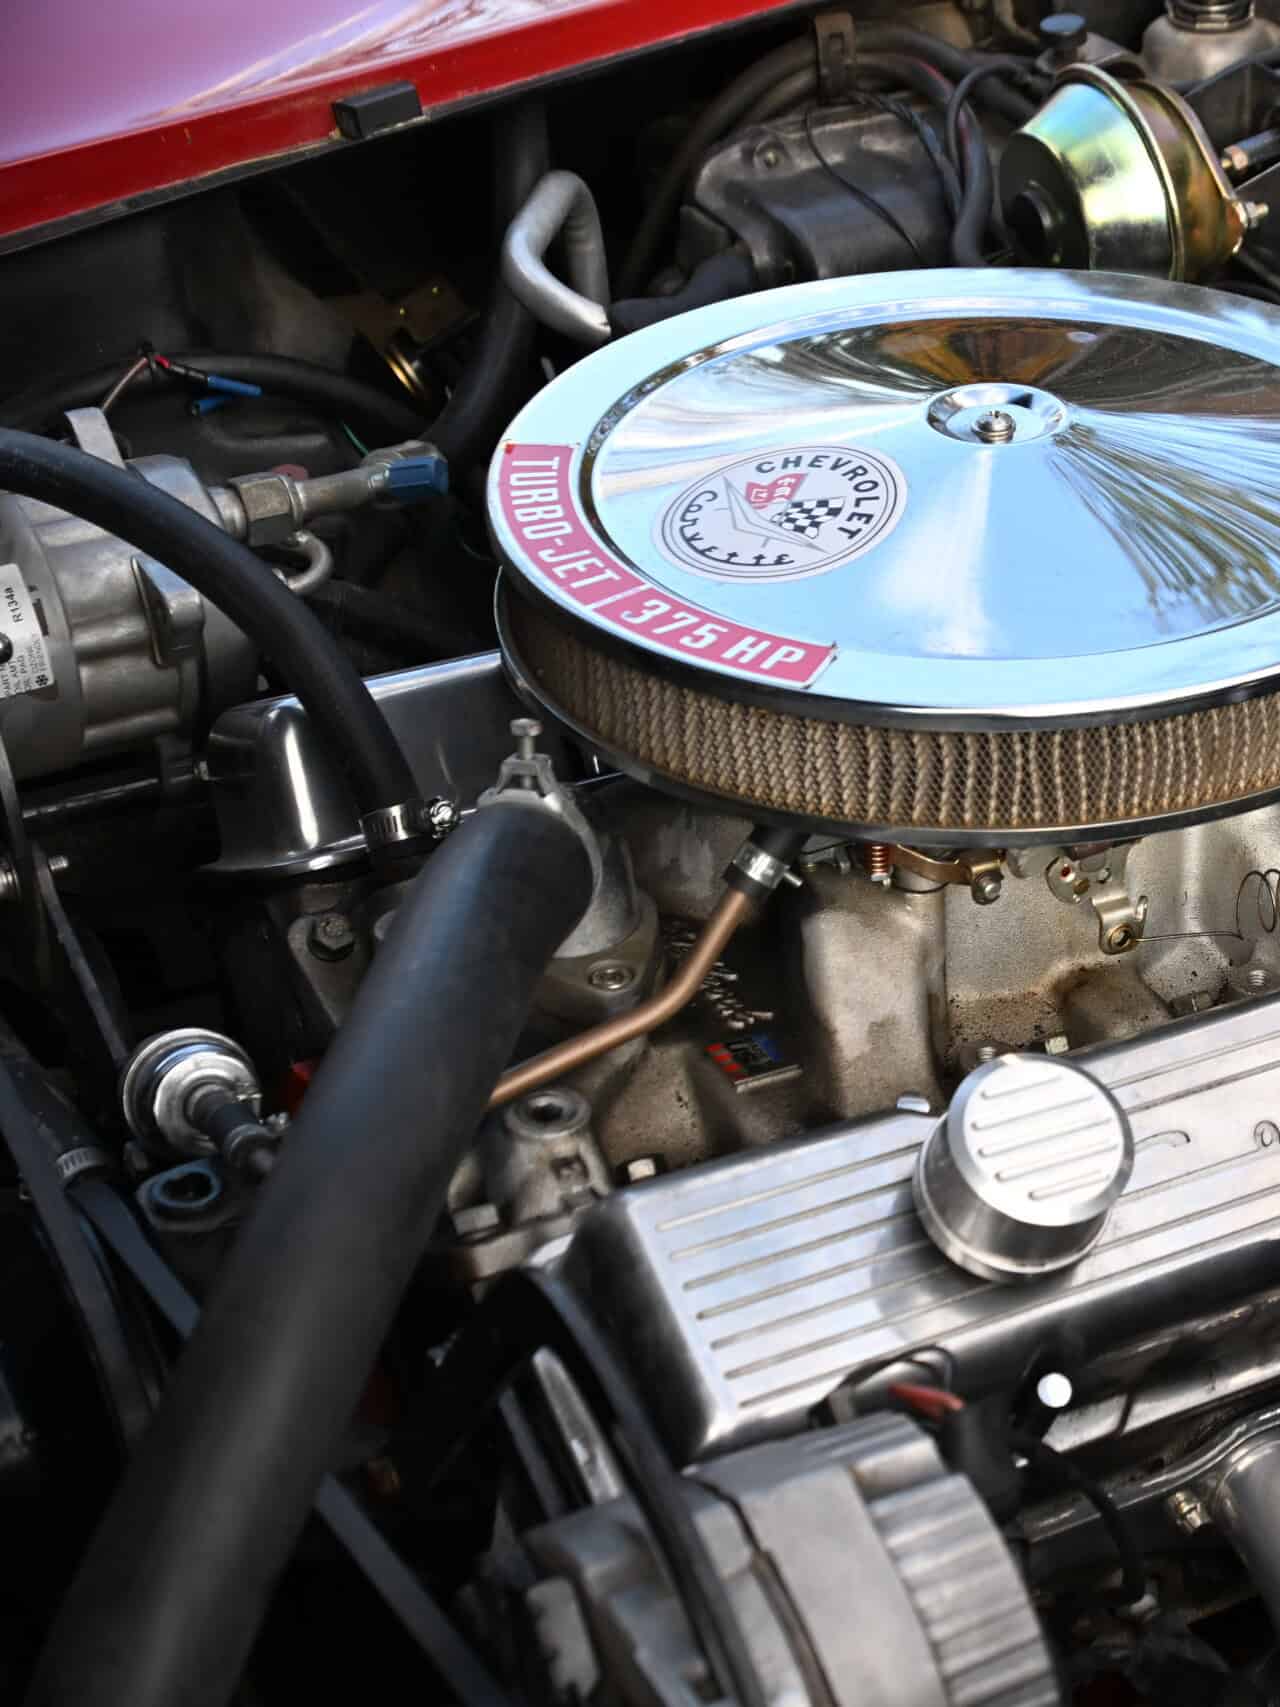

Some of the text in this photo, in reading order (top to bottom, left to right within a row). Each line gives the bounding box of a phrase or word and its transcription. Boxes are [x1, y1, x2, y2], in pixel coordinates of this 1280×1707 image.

[679, 489, 795, 566] Corvette
[755, 454, 880, 541] CHEVROLET
[509, 455, 807, 671] TURBO-JET 375 HP
[4, 586, 24, 623] R134a
